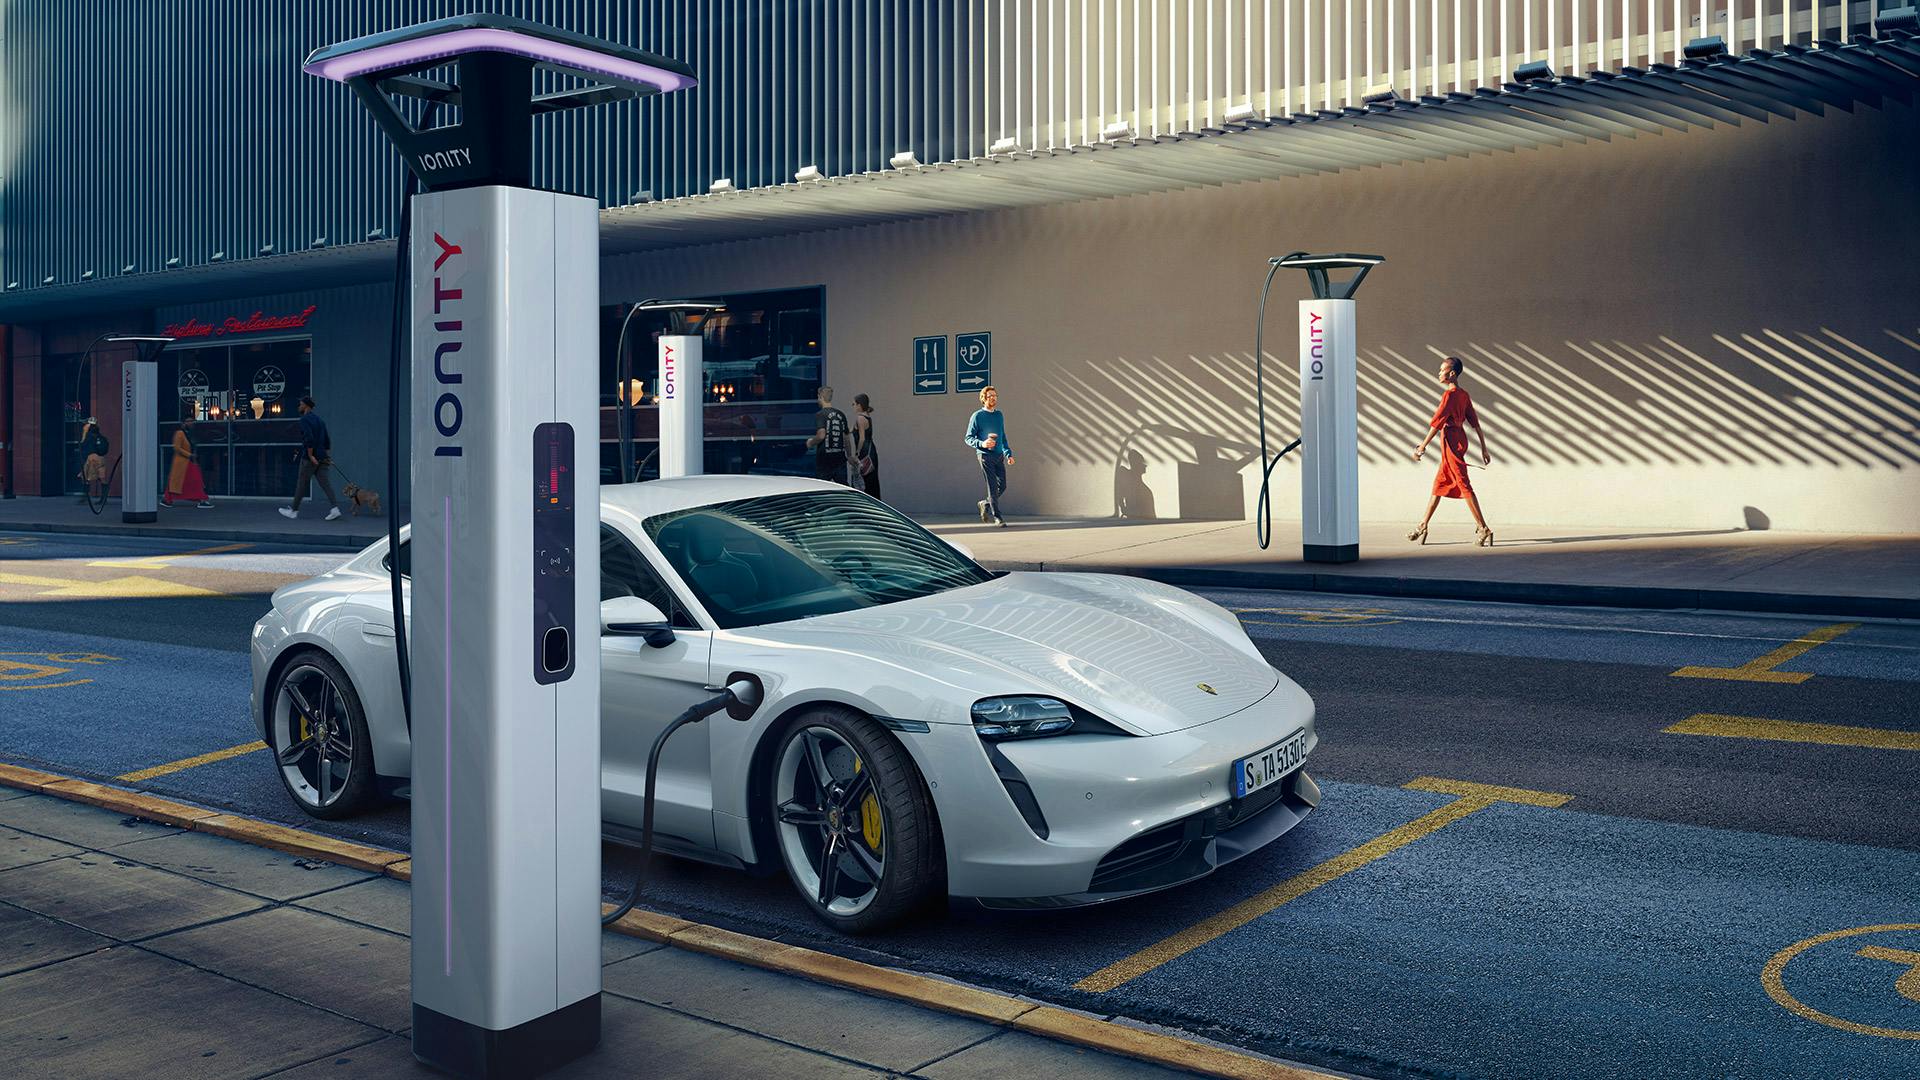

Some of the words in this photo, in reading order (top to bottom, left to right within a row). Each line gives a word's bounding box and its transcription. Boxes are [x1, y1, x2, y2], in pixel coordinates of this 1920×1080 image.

[216, 305, 317, 334] Restaurant
[267, 383, 282, 392] Stop
[1246, 762, 1254, 789] S
[1262, 753, 1275, 781] TA
